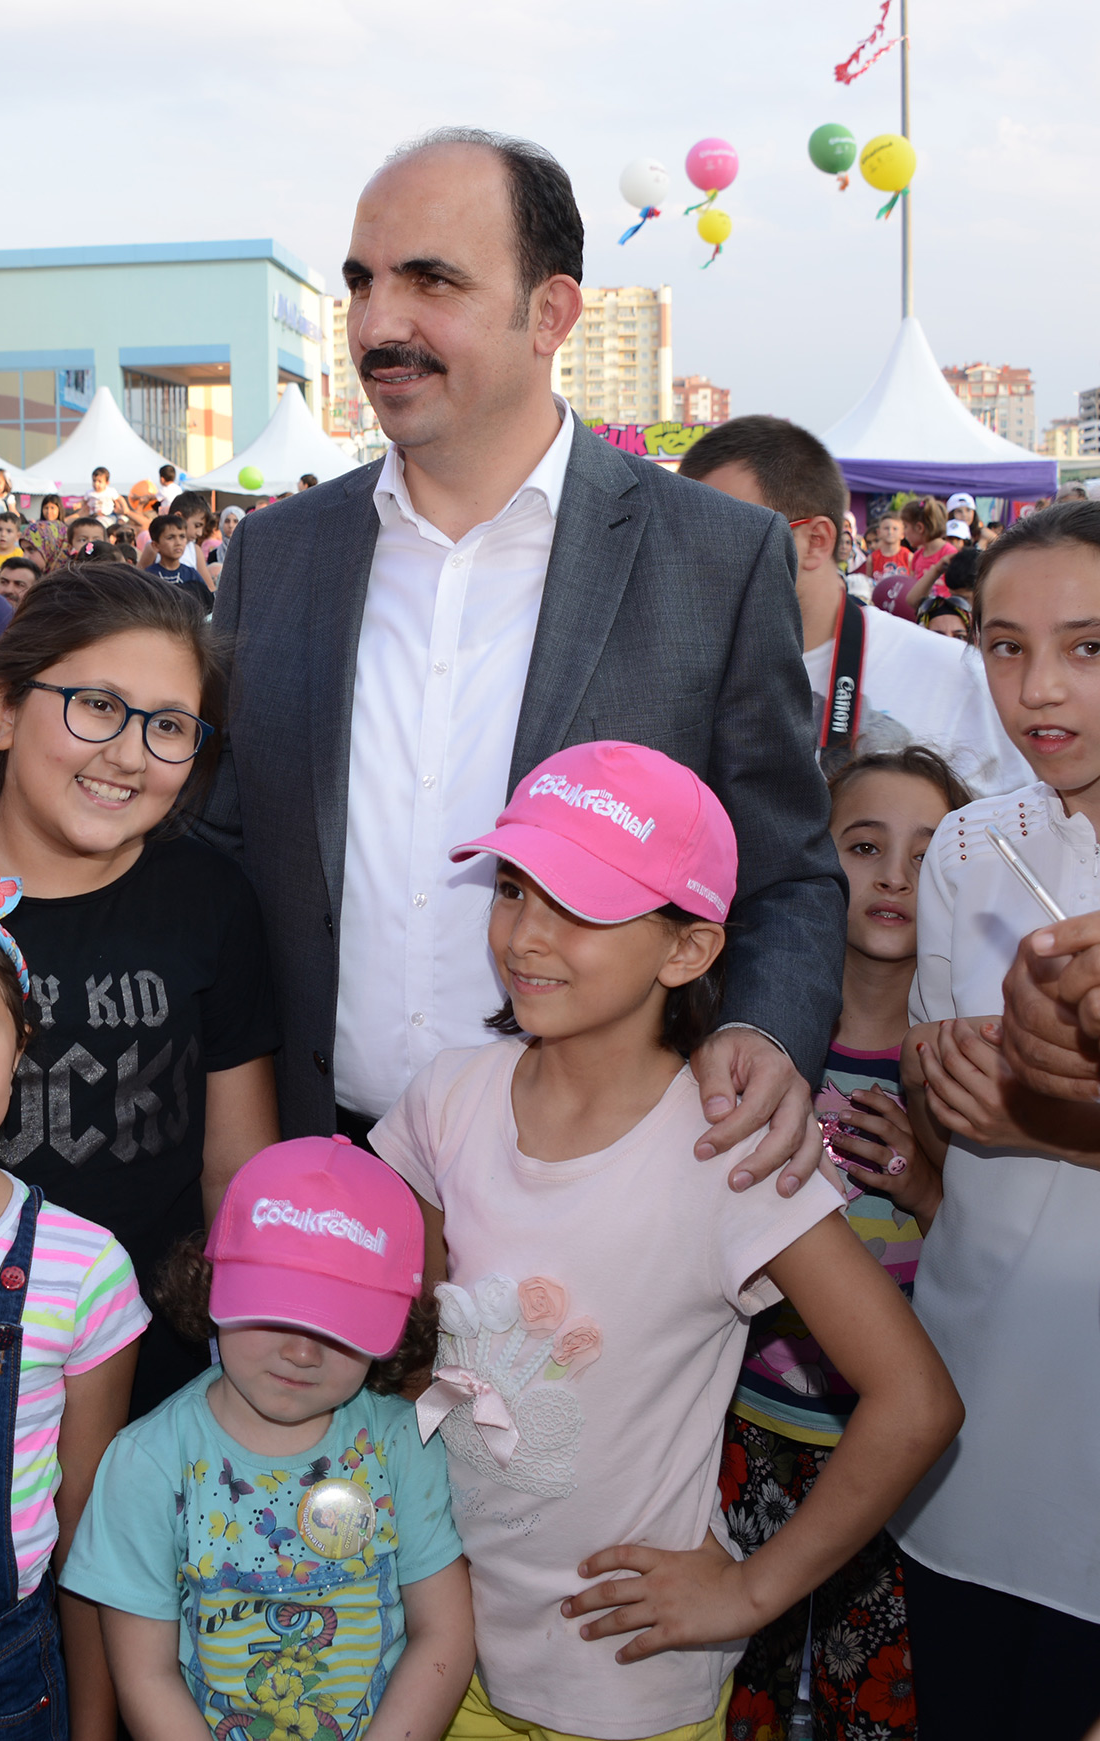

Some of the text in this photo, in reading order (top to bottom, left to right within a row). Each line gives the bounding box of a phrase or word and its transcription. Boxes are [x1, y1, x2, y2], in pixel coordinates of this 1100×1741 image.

[831, 675, 855, 733] Canon
[31, 969, 170, 1030] Y KID
